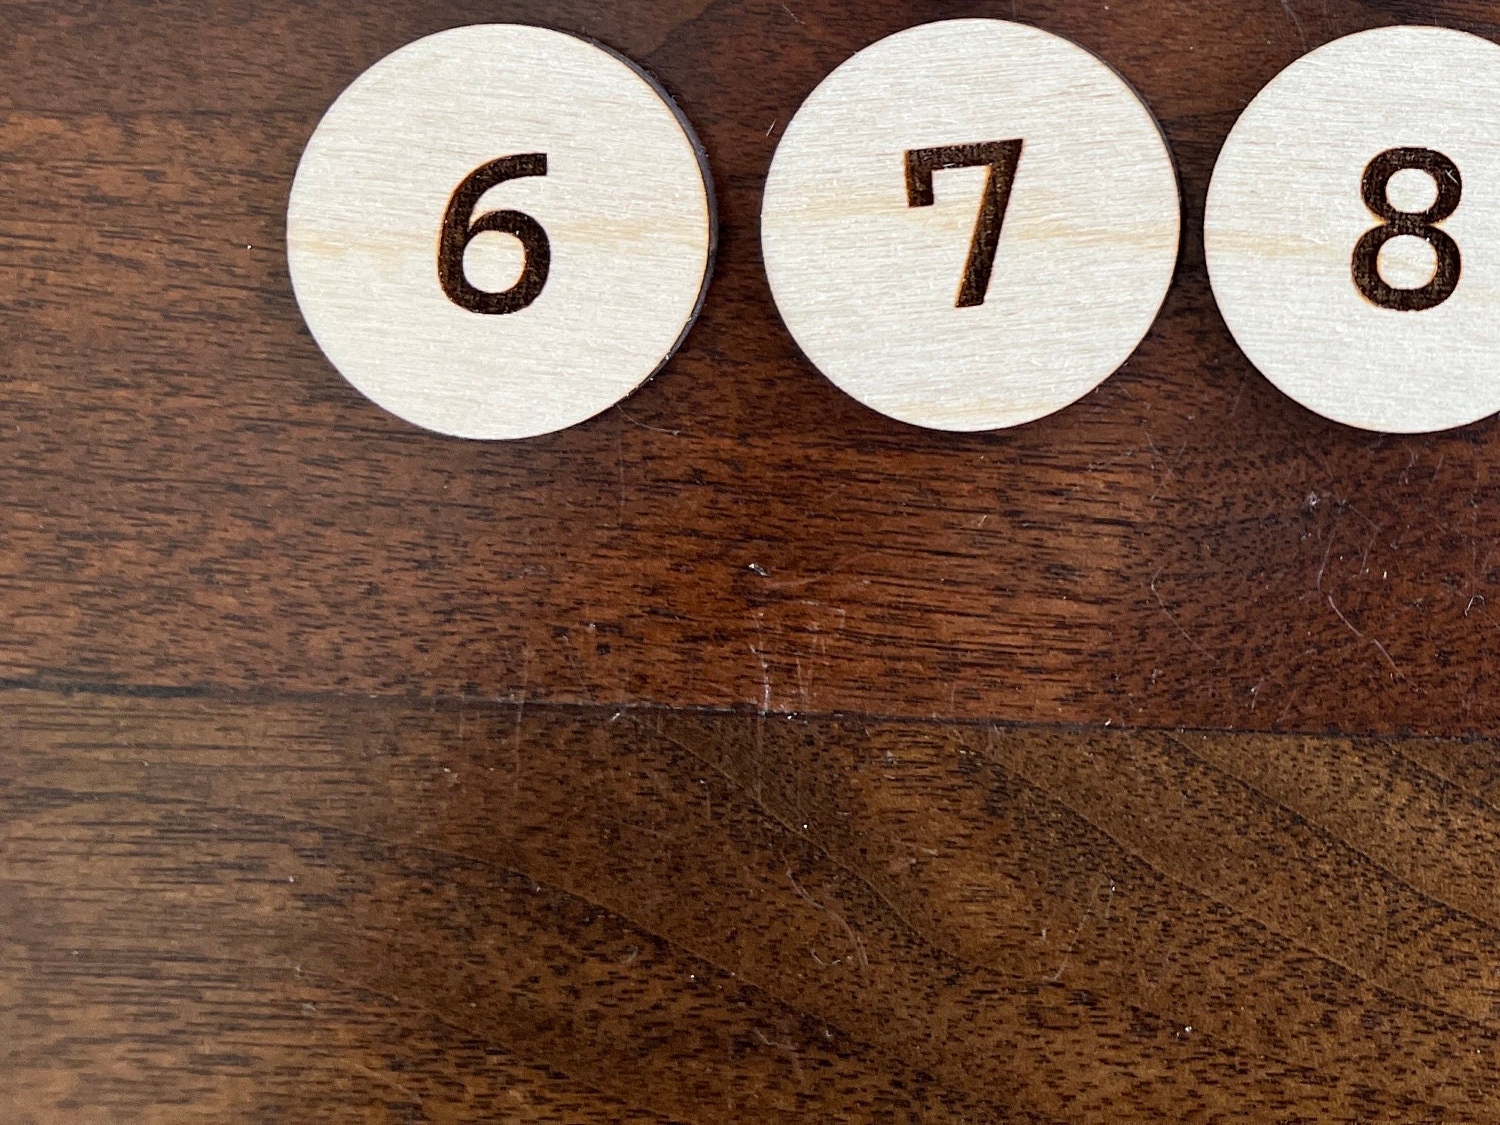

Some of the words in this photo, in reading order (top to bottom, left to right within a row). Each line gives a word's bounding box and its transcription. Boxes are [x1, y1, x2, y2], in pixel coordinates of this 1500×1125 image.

[438, 153, 551, 315] 6
[905, 139, 1023, 308] 7
[1351, 147, 1462, 311] 8
